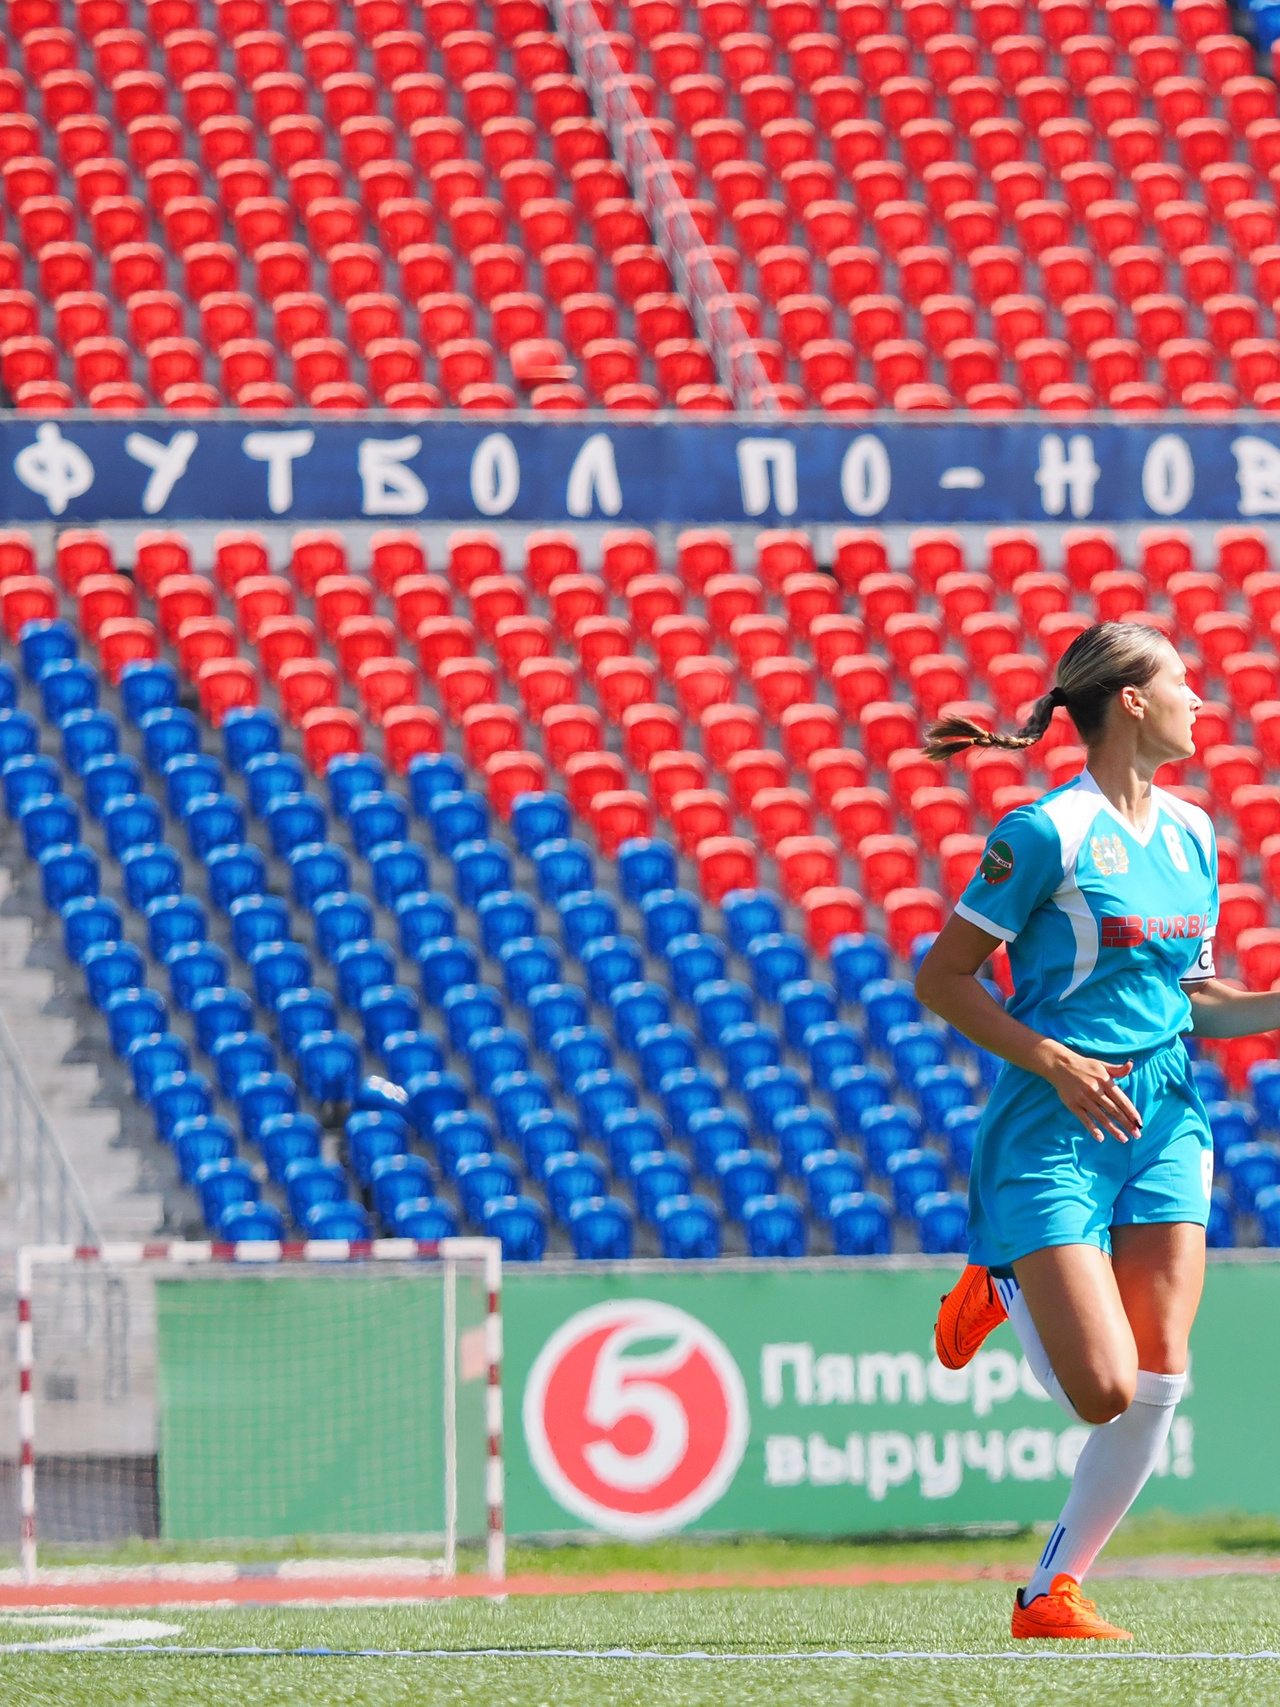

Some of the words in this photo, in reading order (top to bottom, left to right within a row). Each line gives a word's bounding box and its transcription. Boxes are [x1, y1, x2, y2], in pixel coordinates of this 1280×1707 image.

[14, 421, 624, 516] ФУТБОЛ
[583, 1324, 694, 1493] 5
[765, 1414, 1195, 1500] выручае!
